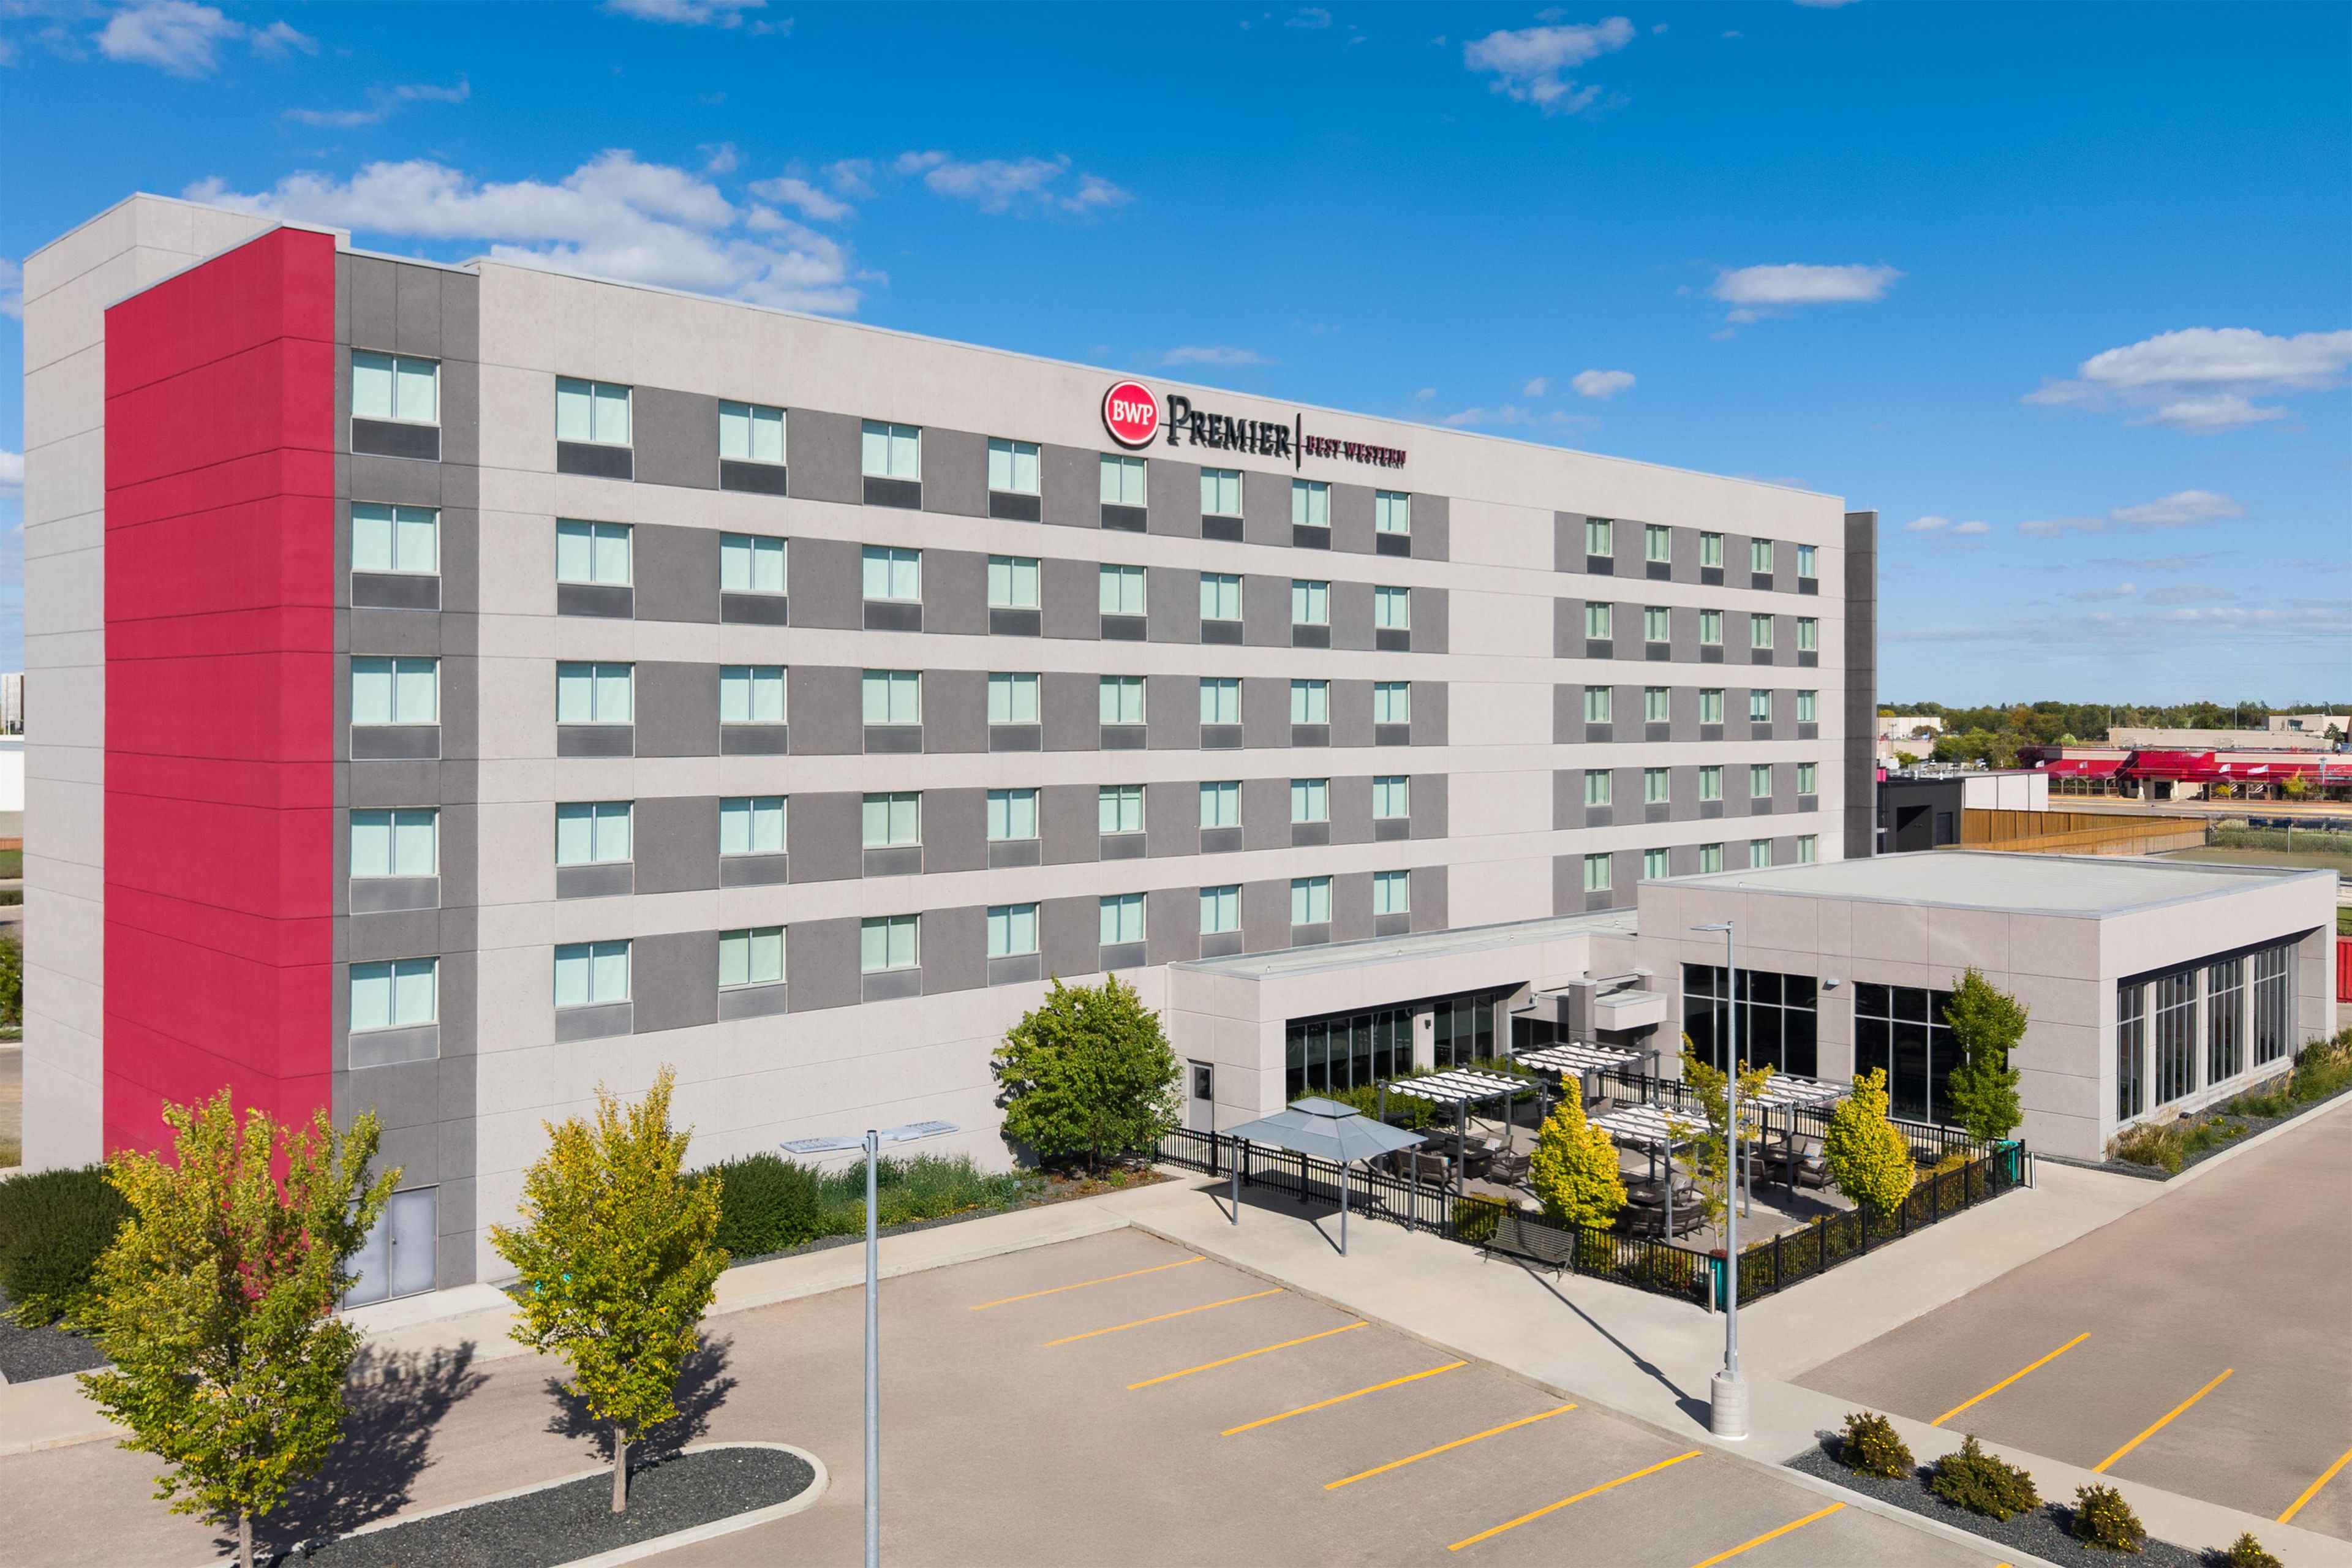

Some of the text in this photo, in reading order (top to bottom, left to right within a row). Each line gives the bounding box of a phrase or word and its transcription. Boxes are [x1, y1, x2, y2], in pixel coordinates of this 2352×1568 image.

[1112, 399, 1154, 426] BWP
[1167, 394, 1292, 455] PREMIER
[1306, 435, 1406, 465] BEST WESTERN
